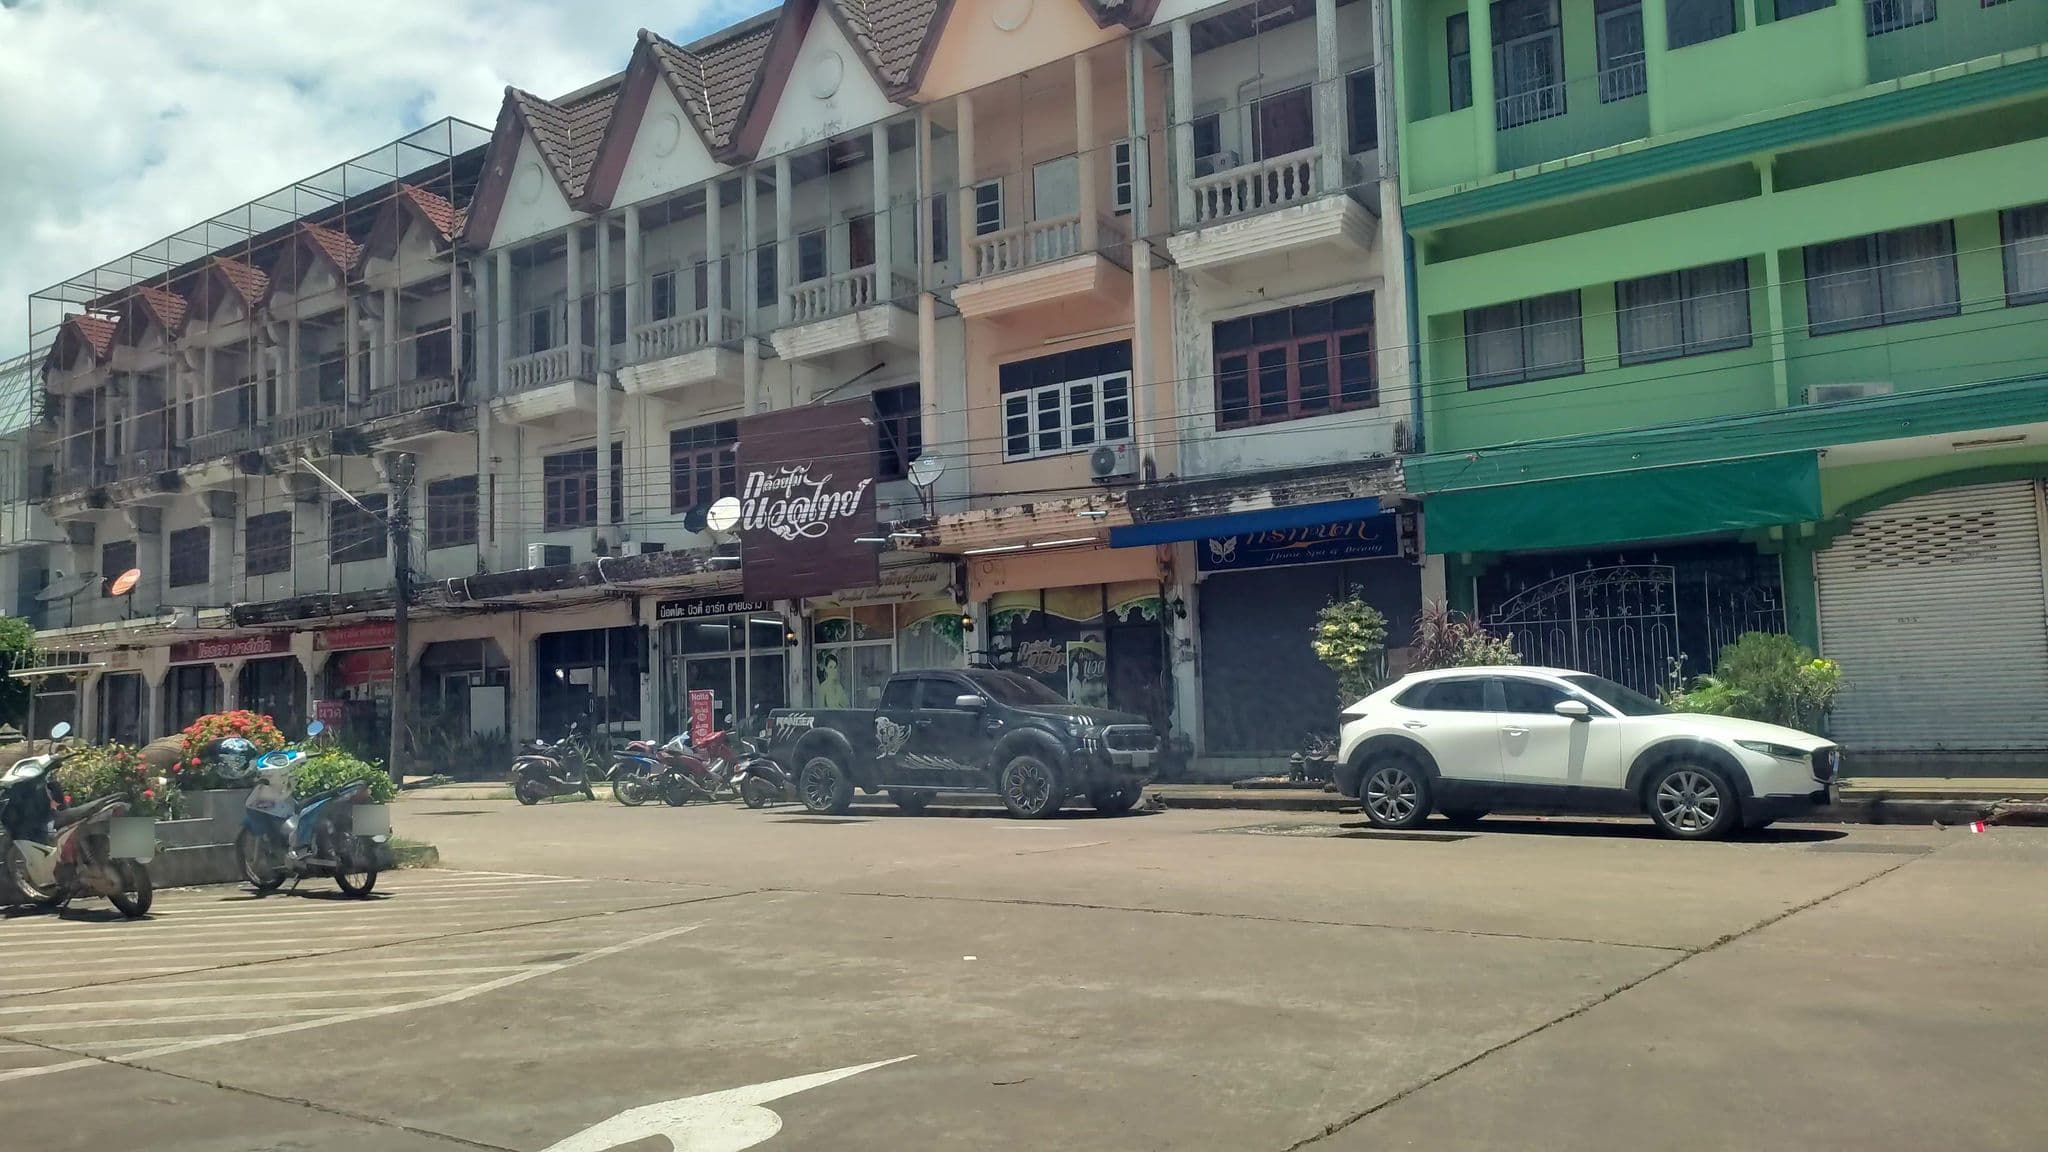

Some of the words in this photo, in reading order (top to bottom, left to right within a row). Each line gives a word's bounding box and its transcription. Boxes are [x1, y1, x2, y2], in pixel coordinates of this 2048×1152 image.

[742, 459, 813, 499] กล้วยไม้
[776, 716, 815, 729] RANGER
